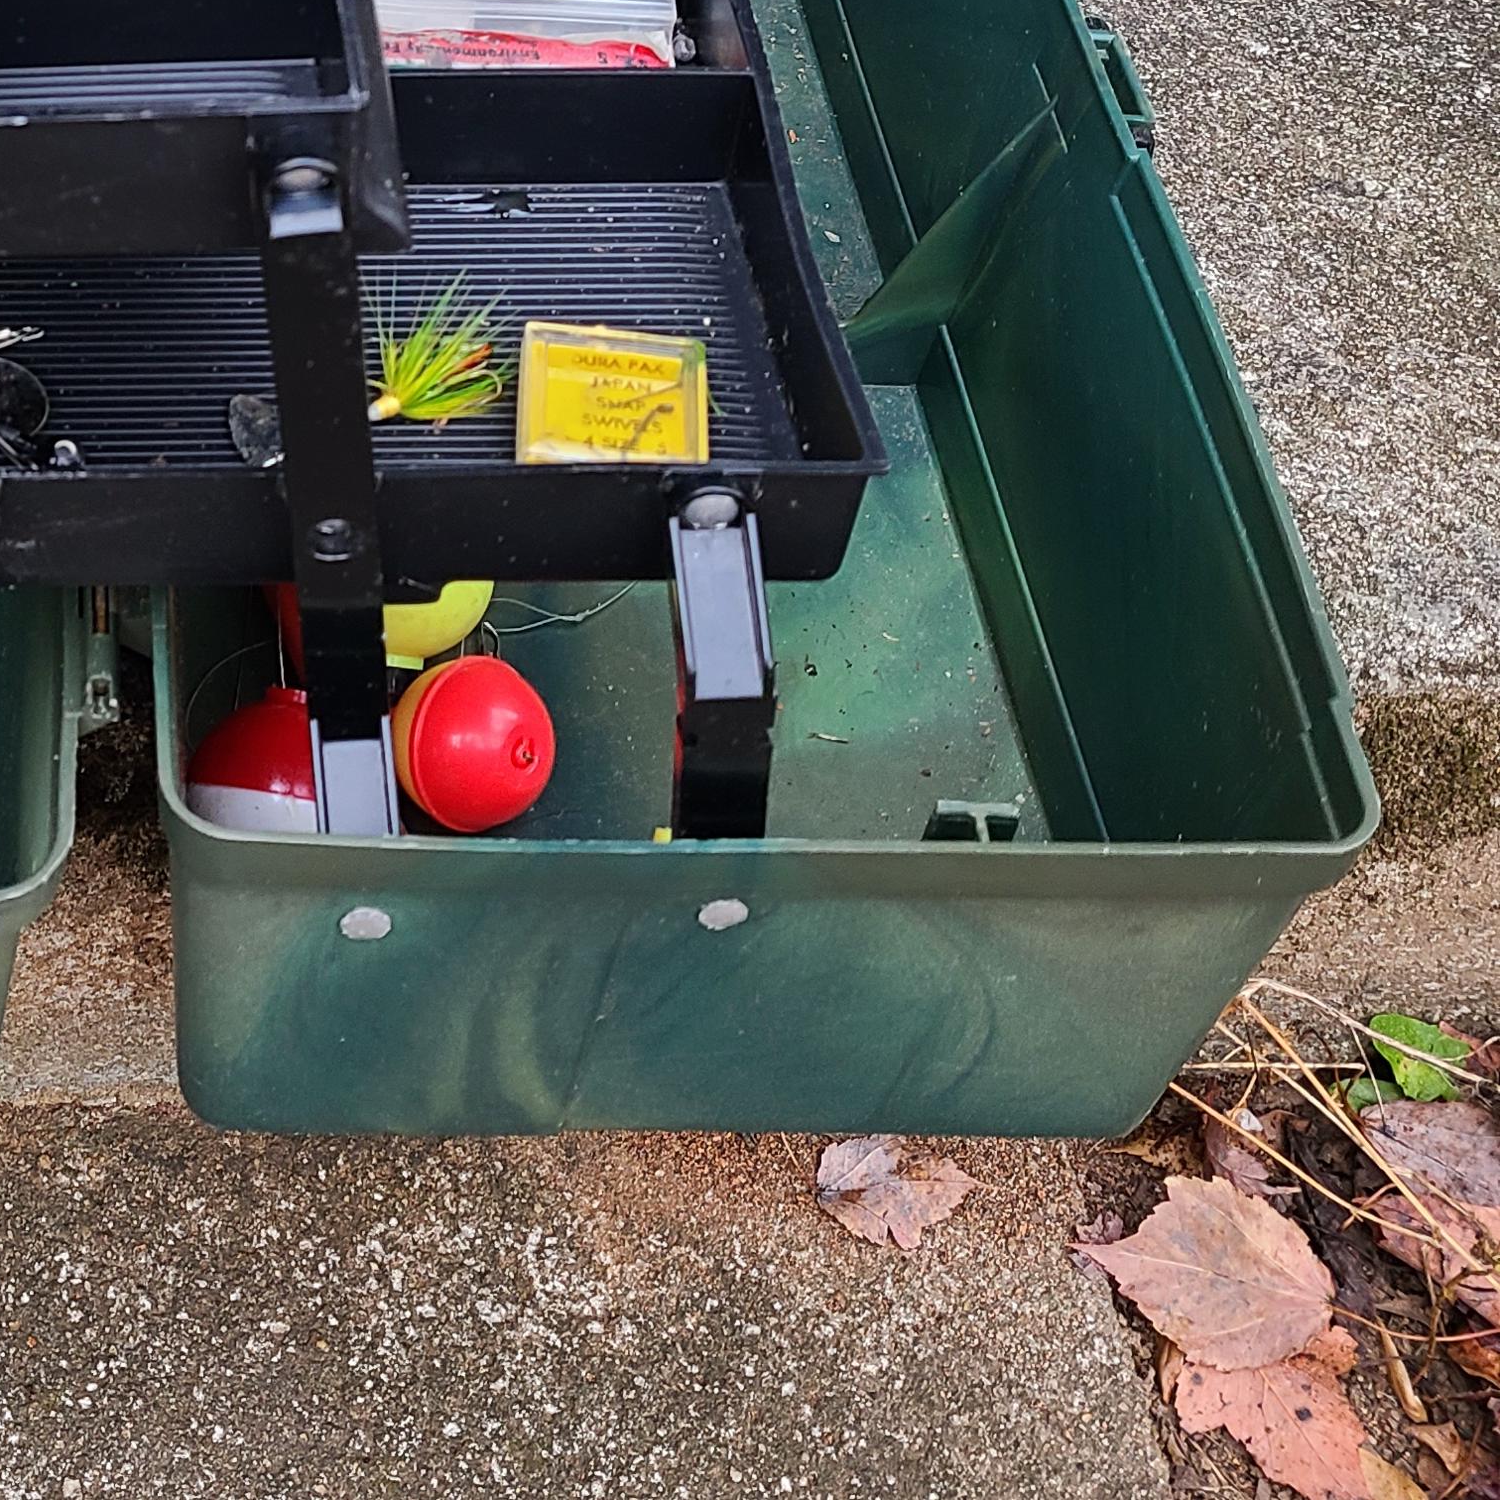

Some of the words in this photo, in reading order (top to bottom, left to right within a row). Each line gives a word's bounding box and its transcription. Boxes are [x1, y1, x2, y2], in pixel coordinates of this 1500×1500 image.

[571, 353, 621, 369] DURA
[628, 359, 666, 375] PAK
[591, 376, 651, 394] JAPAN
